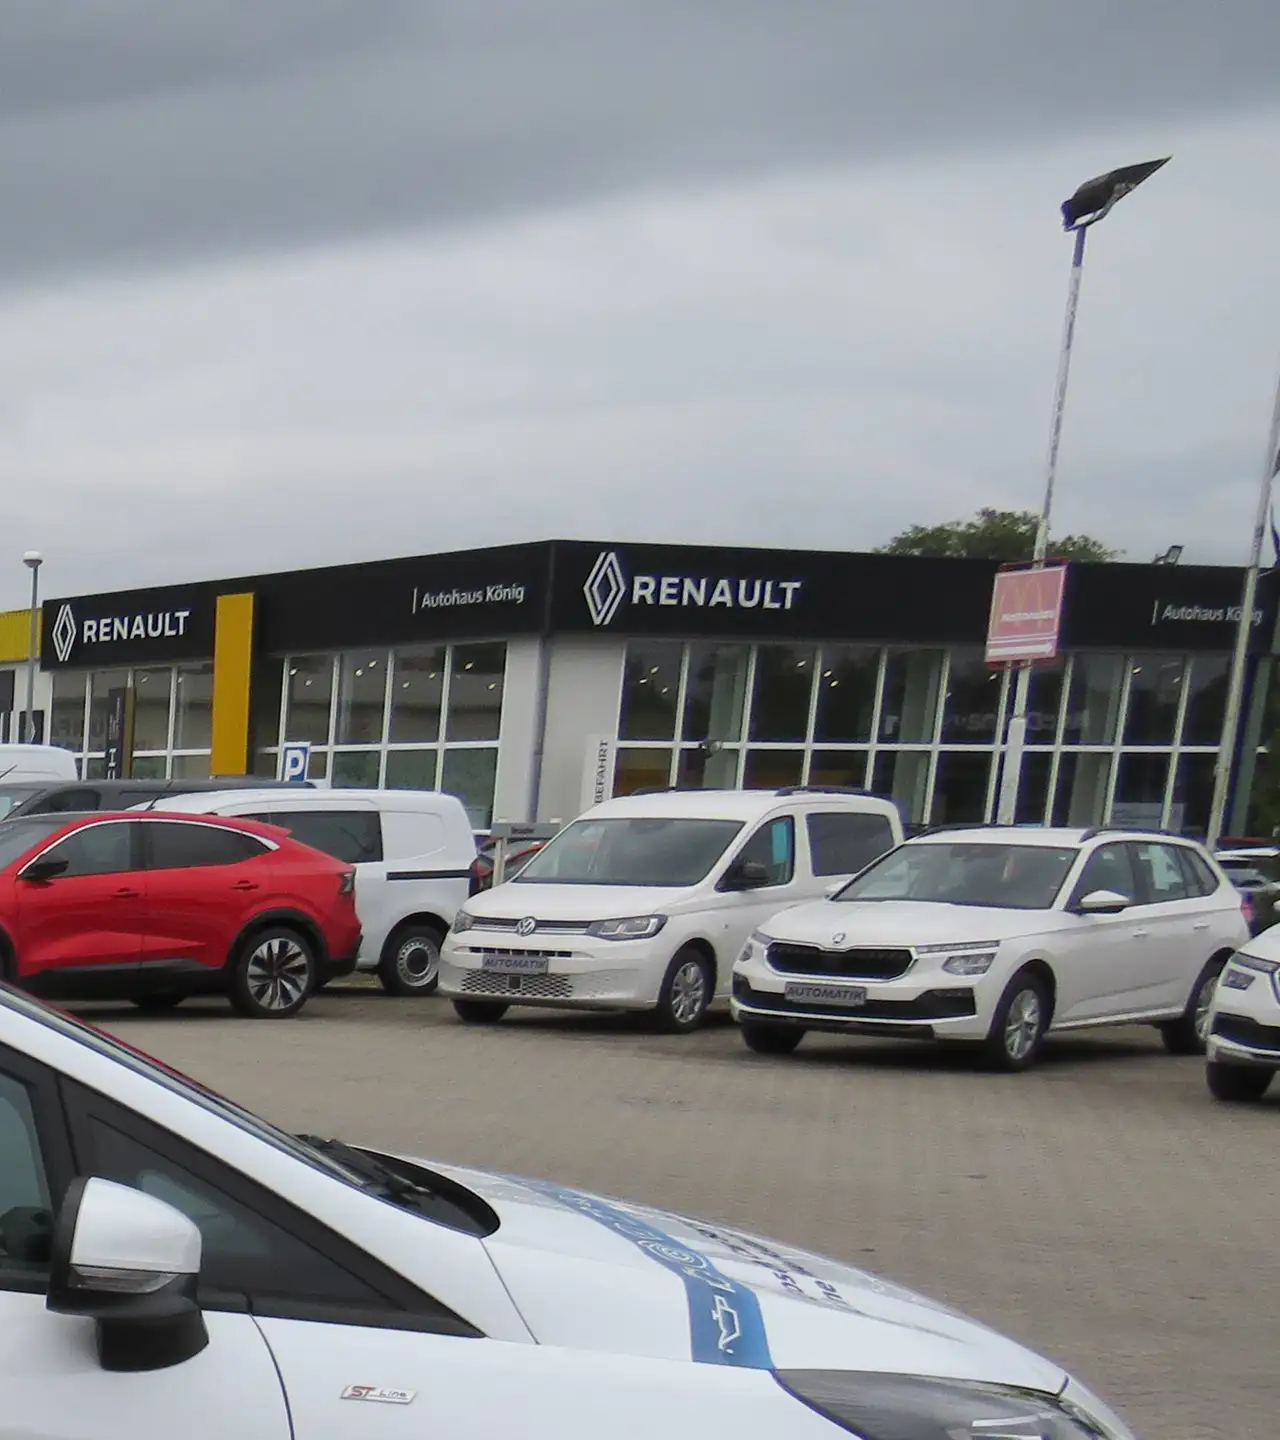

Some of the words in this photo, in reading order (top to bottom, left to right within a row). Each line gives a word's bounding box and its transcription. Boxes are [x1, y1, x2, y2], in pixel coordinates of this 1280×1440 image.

[421, 588, 483, 609] Autohaus
[485, 582, 525, 604] König
[631, 575, 802, 610] RENAULT
[82, 610, 190, 644] RENAULT
[1161, 604, 1224, 621] Autohaus
[284, 749, 305, 782] P
[786, 986, 864, 999] AUTOMATIK
